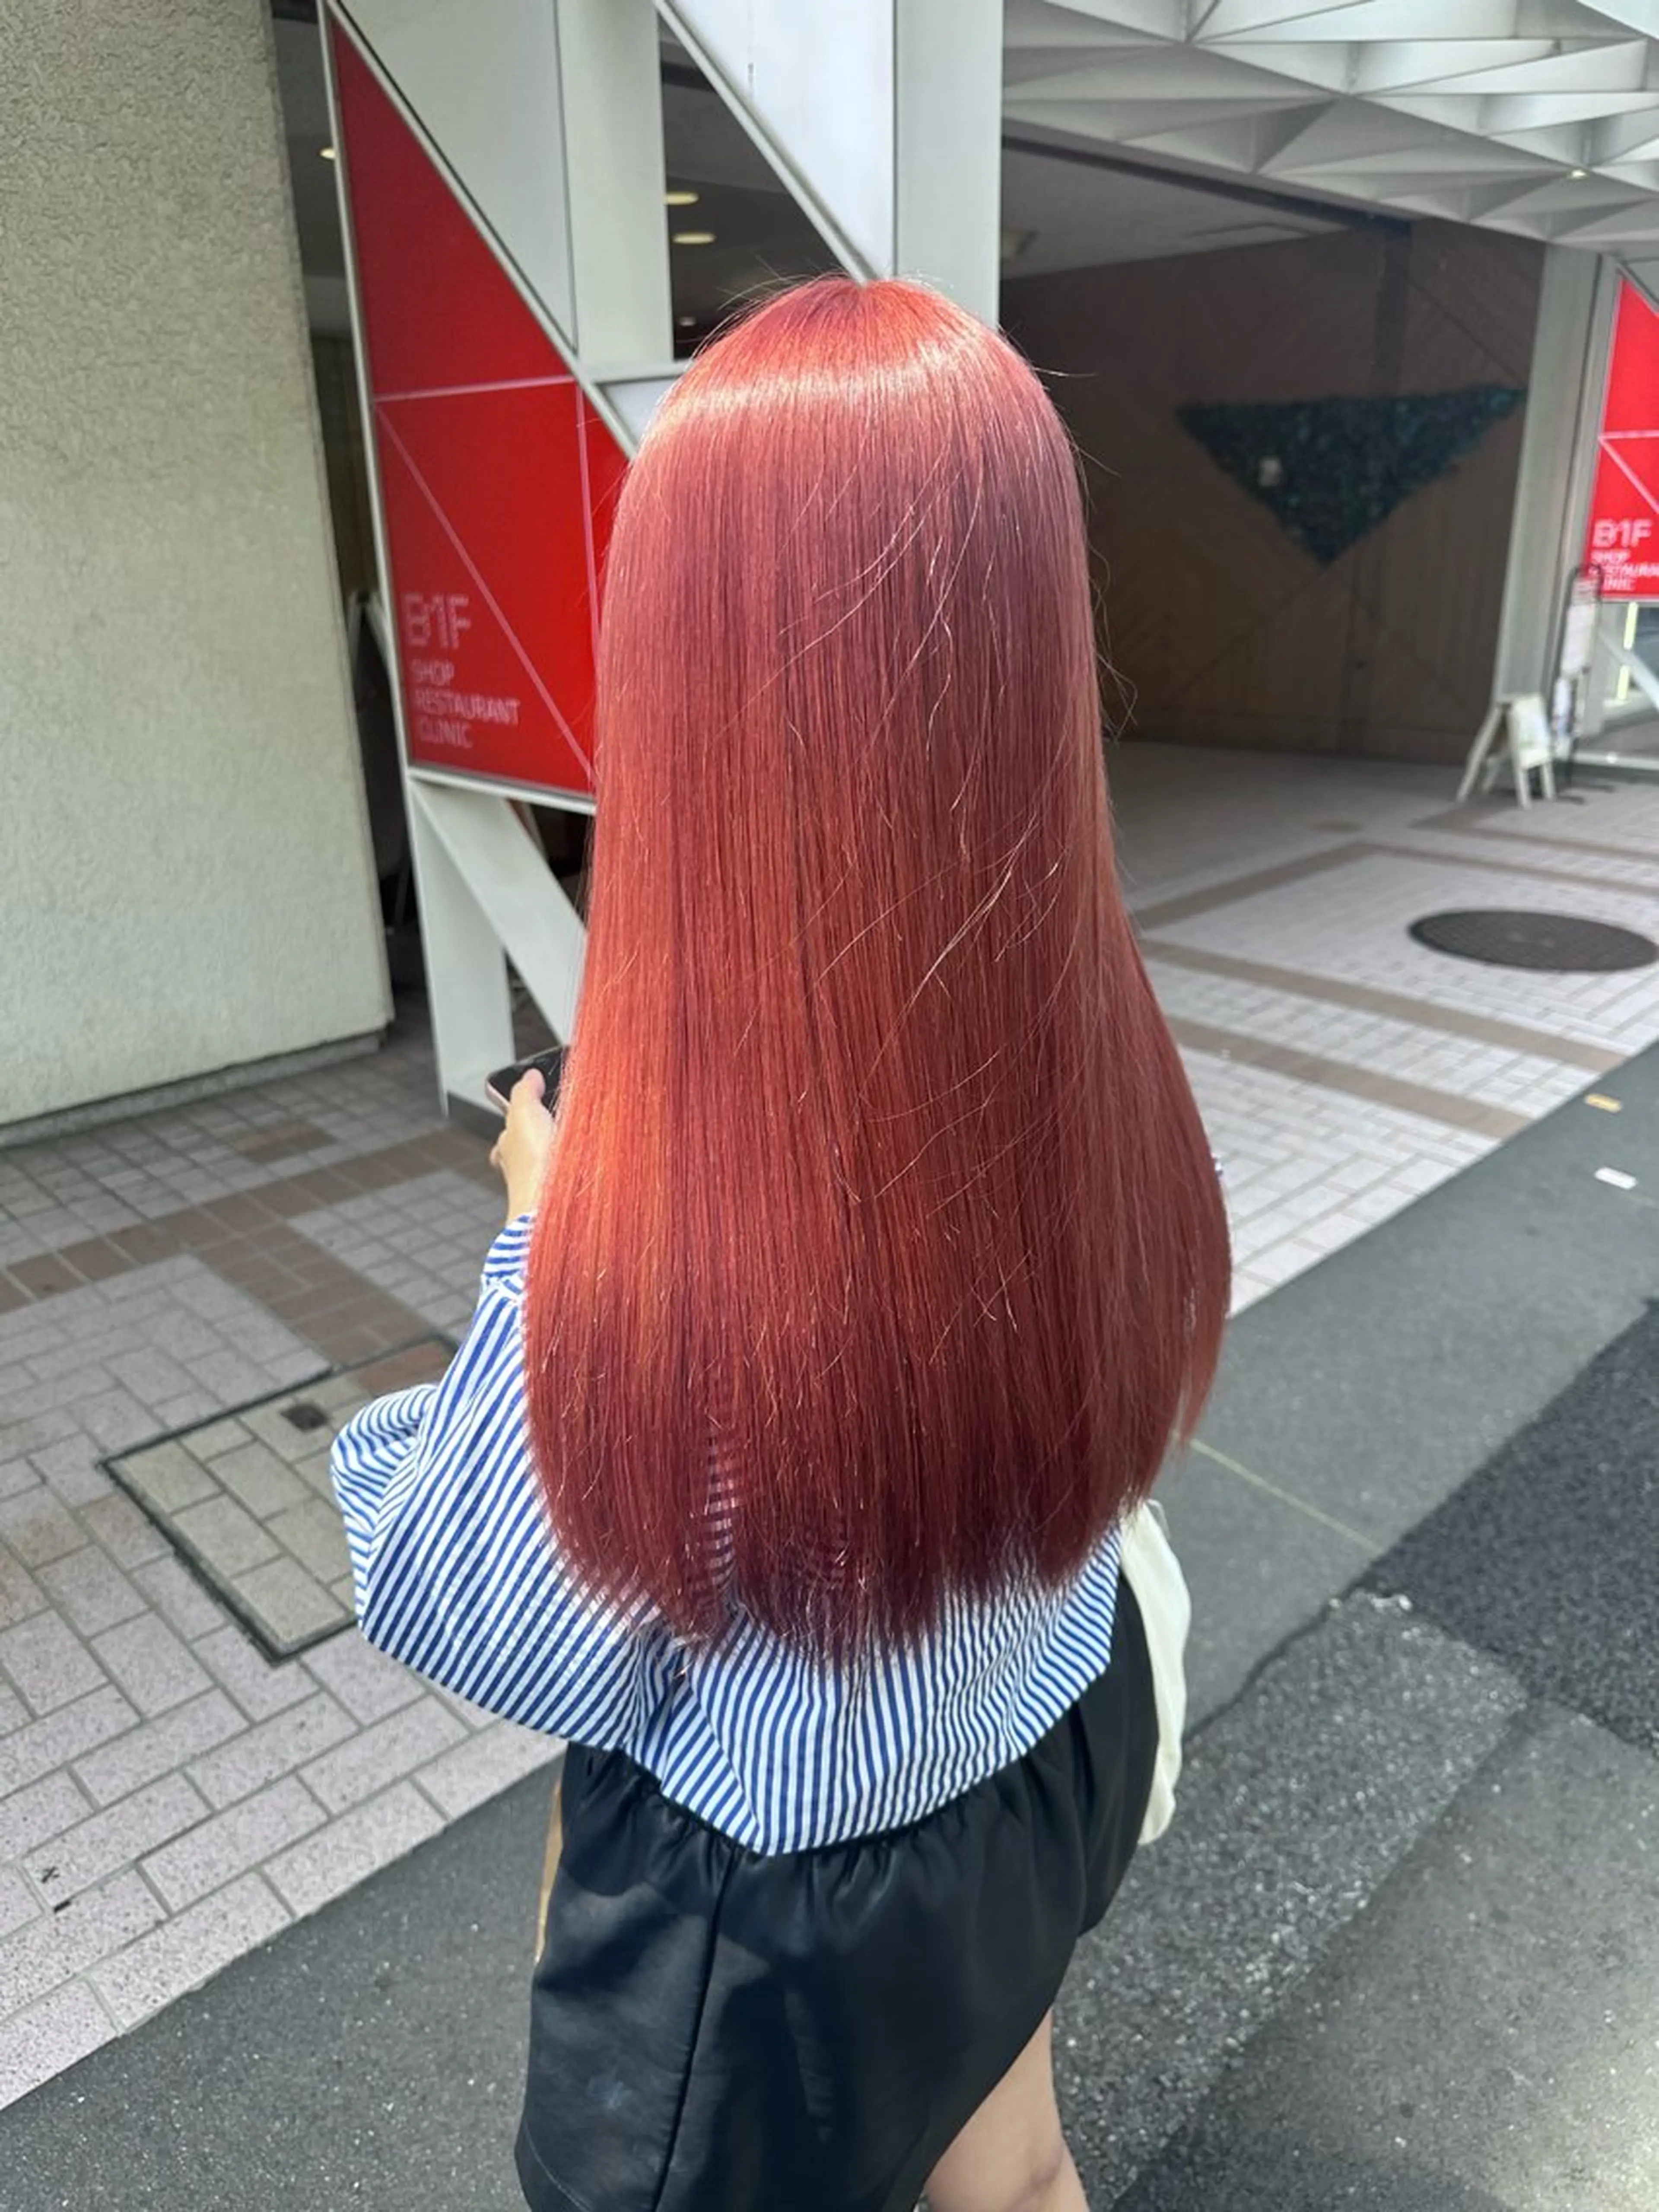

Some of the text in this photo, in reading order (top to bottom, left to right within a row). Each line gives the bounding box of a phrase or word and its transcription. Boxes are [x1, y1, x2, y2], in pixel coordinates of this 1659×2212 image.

[1592, 519, 1652, 548] B1F
[404, 592, 471, 650] B1F
[411, 658, 455, 686] SHOP
[414, 687, 521, 727] RESTAURANT
[417, 715, 474, 749] CLINIC
